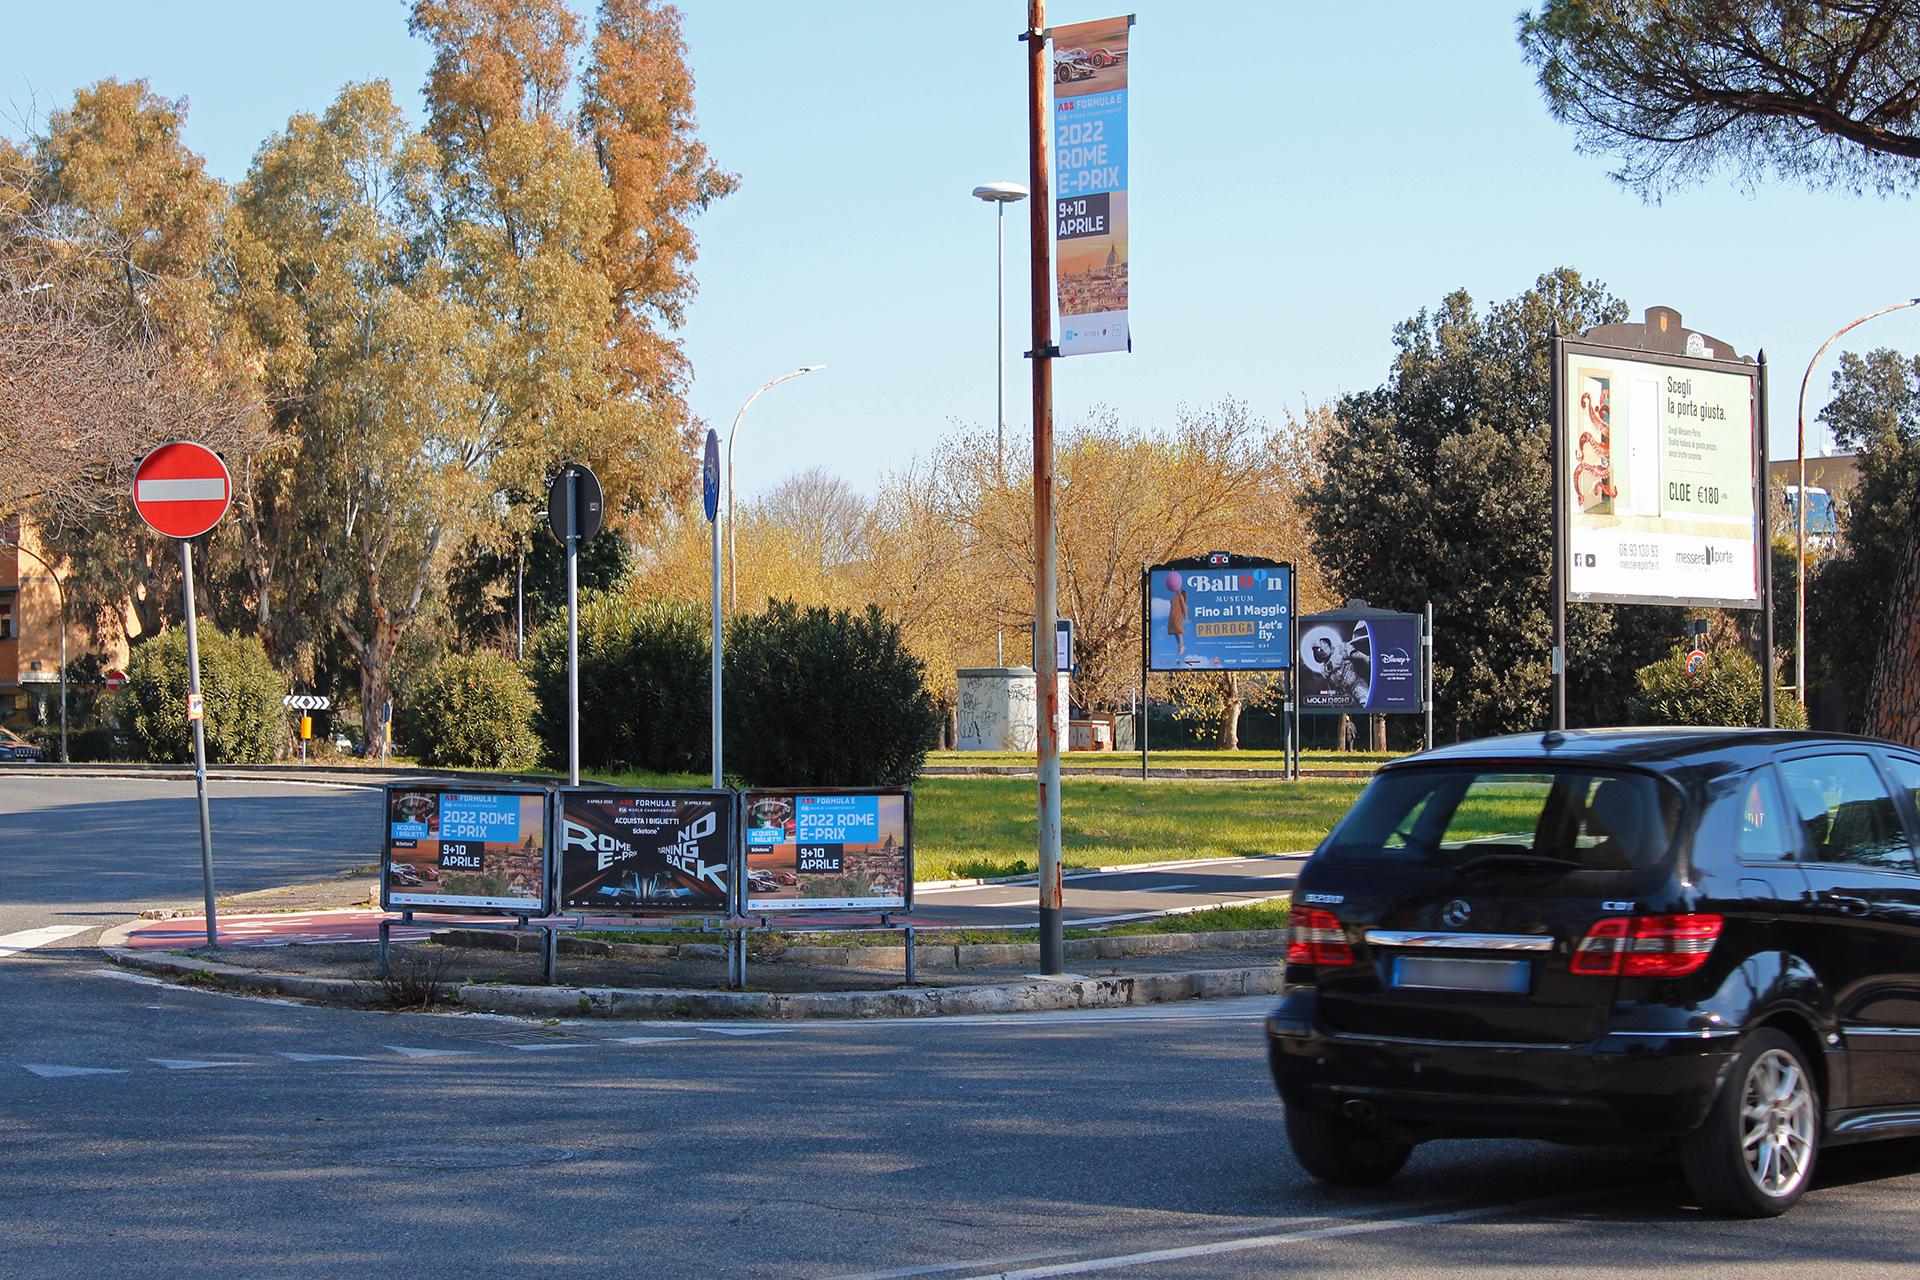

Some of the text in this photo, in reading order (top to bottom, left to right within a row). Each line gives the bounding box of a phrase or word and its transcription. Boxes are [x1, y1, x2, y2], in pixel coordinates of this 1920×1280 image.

[1058, 94, 1122, 112] ABB FORMULA E
[1058, 120, 1104, 146] 2022
[1058, 144, 1108, 170] ROME
[1058, 166, 1119, 194] E-PRIX
[1059, 200, 1087, 218] 9+10
[1058, 215, 1104, 236] APRILE
[1667, 375, 1691, 398] Scegli
[1667, 397, 1727, 421] la porta giusta.
[1669, 481, 1719, 504] CLOE €180
[1619, 543, 1628, 557] 06
[1628, 543, 1638, 557] 93
[1649, 545, 1659, 558] 93
[1187, 569, 1282, 592] Balloon
[1195, 604, 1287, 617] Fino al 1 Maggio
[1198, 623, 1253, 636] PROROGA
[1258, 620, 1283, 630] Let's
[1258, 629, 1275, 641] fly.
[460, 794, 492, 803] FORMULA
[493, 795, 498, 803] E
[635, 799, 671, 807] FORMULA
[816, 797, 850, 805] FORMULA
[443, 811, 516, 825] 2022 ROME
[614, 817, 645, 825] ACQUISTA
[800, 813, 874, 827] 2022 ROME
[443, 825, 488, 838] E-PRIX
[633, 827, 658, 835] ticketone
[678, 811, 716, 842] NO
[800, 827, 846, 840] E-PRIX
[563, 819, 632, 851] ROME
[443, 844, 466, 855] 9+10
[658, 840, 699, 858] TURNING
[801, 848, 825, 859] 9+10
[442, 856, 480, 867] APRILE
[597, 852, 637, 871] E-PRIX
[800, 859, 840, 870] APRILE
[666, 854, 727, 894] BACK
